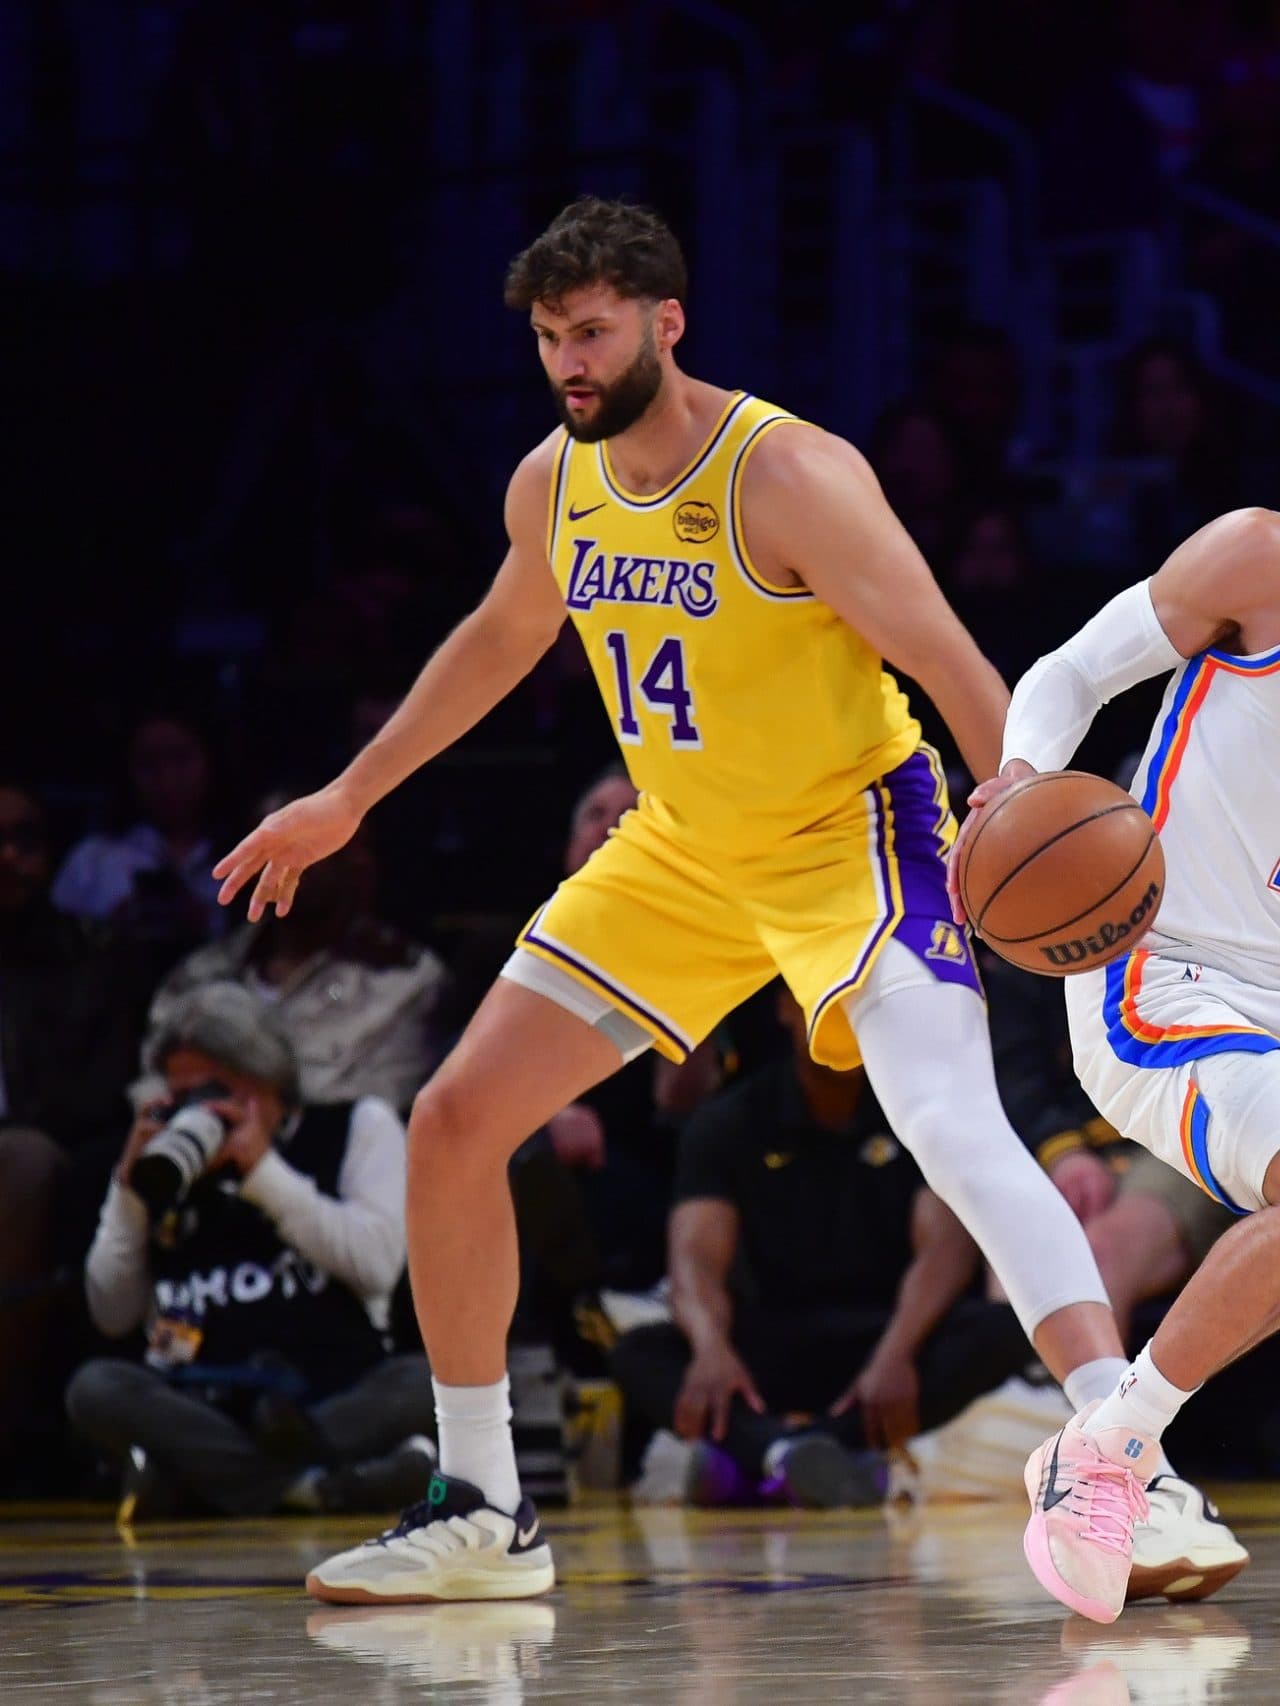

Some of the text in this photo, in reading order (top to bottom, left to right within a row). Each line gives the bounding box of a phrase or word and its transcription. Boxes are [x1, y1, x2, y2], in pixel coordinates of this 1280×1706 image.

[565, 538, 718, 618] LAKERS
[605, 630, 703, 750] 14
[1040, 881, 1159, 966] Wilson
